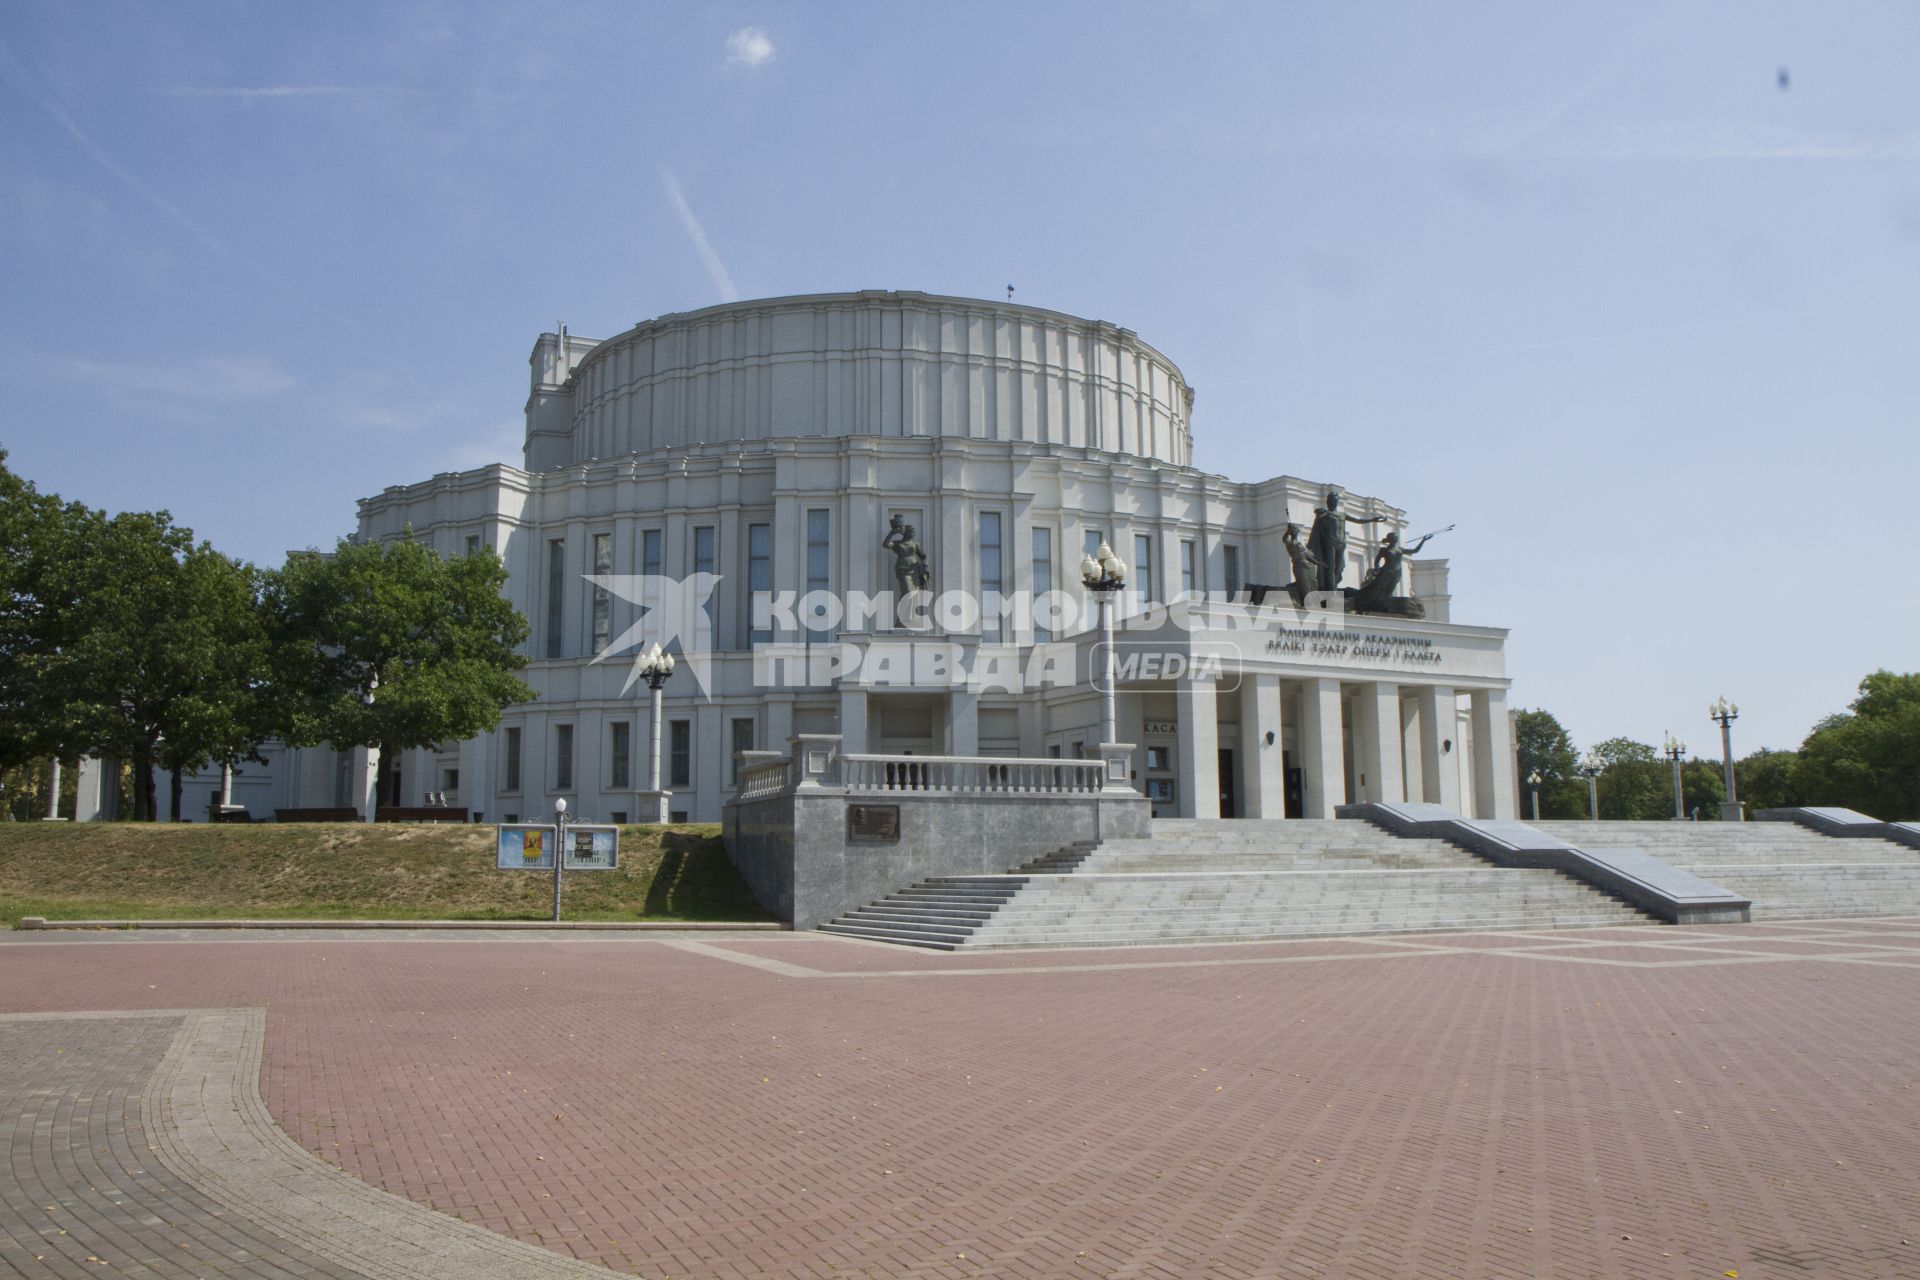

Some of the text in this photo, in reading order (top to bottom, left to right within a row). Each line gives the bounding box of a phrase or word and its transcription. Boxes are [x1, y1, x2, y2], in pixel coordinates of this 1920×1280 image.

[1268, 640, 1305, 652] ВЯЛІКІ
[1312, 643, 1348, 655] ТЭАТР
[1353, 646, 1391, 658] ОПЕРЫ
[1404, 650, 1442, 662] БАЛЕТА
[1143, 723, 1176, 733] КАСА
